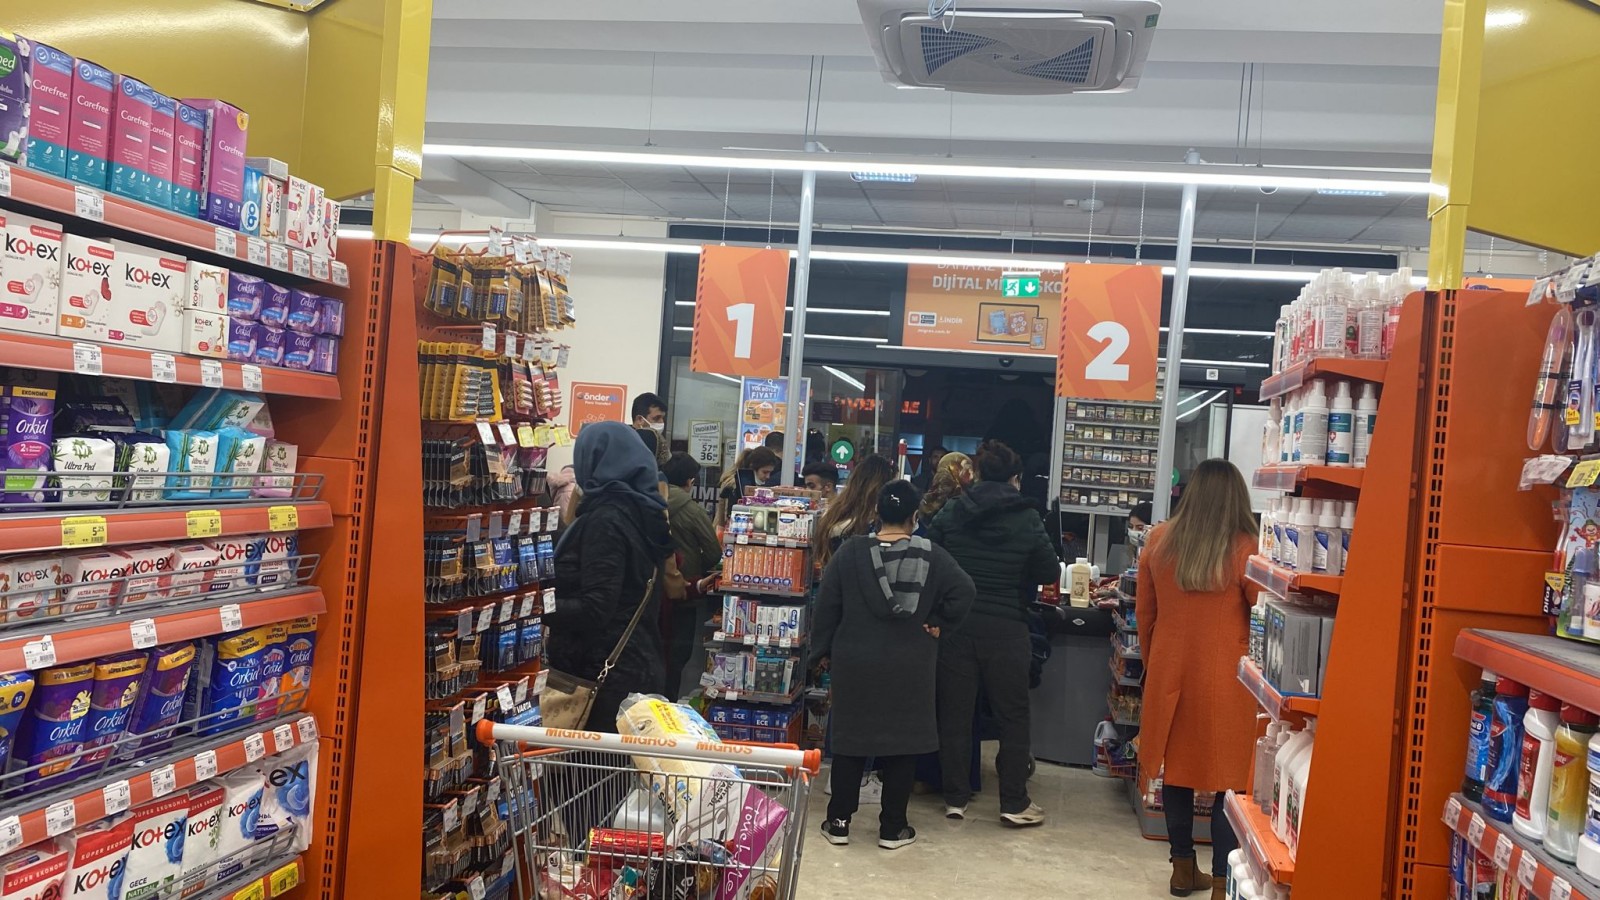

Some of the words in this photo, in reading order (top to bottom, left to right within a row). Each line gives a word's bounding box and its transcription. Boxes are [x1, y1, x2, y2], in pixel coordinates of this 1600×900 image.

[33, 80, 68, 100] Carefree
[77, 95, 110, 114] Carefree
[121, 110, 149, 128] Carefree
[726, 302, 755, 359] 1
[1085, 320, 1130, 382] 2
[584, 392, 611, 401] önder
[16, 418, 49, 436] Orkid
[700, 452, 713, 461] 36
[702, 444, 713, 452] 57
[494, 542, 512, 551] VARTA
[290, 649, 312, 665] Orkid
[230, 669, 260, 687] Orkid
[516, 701, 532, 714] VARTA
[94, 708, 130, 732] Orkid
[50, 719, 83, 742] Orkid
[129, 877, 148, 889] GECE
